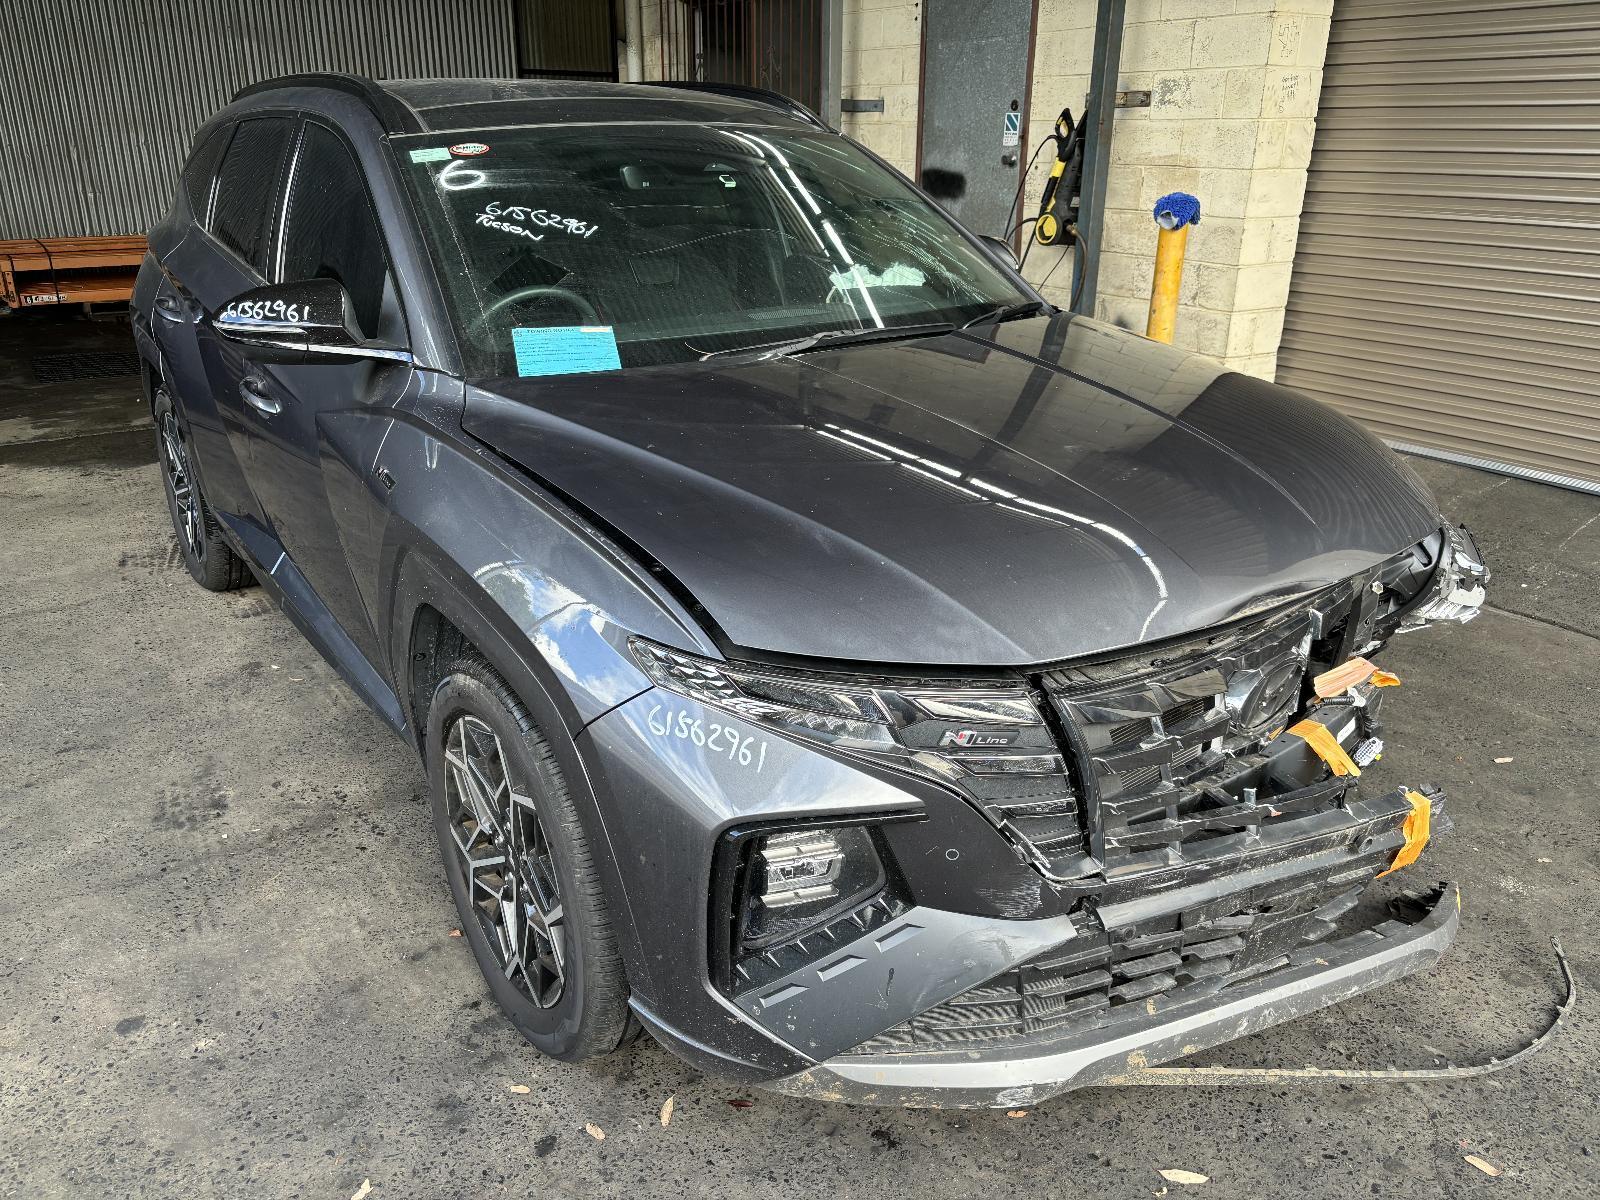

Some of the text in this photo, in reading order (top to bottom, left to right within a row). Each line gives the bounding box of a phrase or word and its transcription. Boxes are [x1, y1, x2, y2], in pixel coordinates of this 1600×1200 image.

[485, 201, 599, 238] 61562961
[226, 299, 310, 322] 61562961
[648, 704, 767, 773] 61562961
